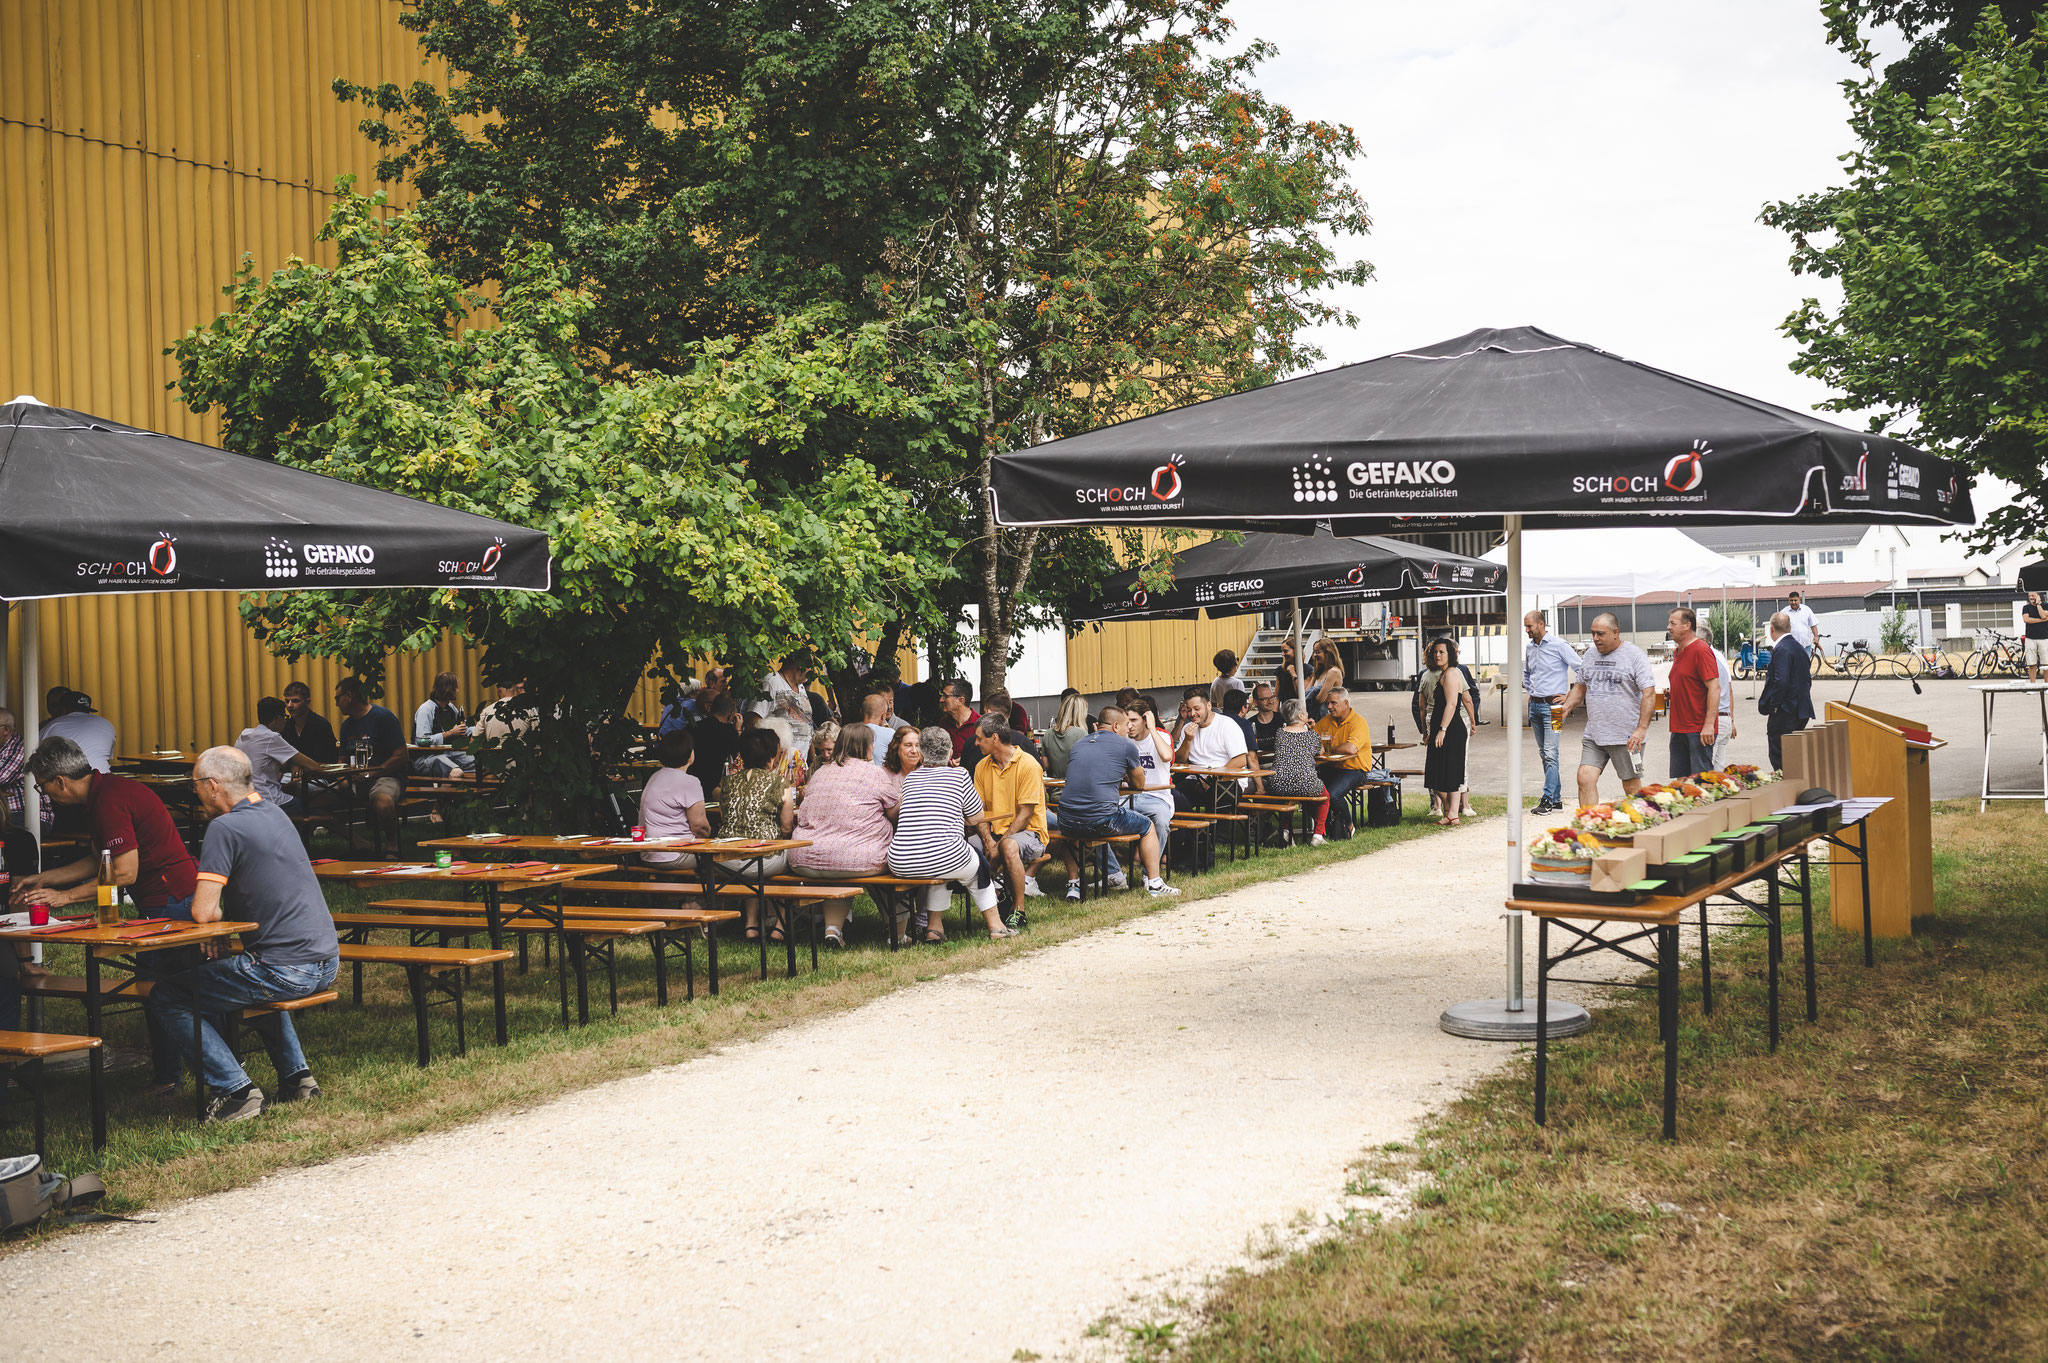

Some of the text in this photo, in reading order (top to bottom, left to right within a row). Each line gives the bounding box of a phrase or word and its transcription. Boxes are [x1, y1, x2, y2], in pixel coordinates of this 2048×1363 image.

[1346, 460, 1456, 486] GEFAKO
[1572, 476, 1659, 493] SCHOCH
[1075, 486, 1146, 503] SCHOCH
[1349, 487, 1458, 500] Die Getränkespezialisten
[303, 544, 375, 564] GEFAKO
[77, 561, 147, 576] SCHOCH
[305, 567, 376, 577] Die Getränkespezialisten
[438, 560, 480, 573] SCHOCH
[1218, 578, 1264, 593] GEFAKO
[1311, 578, 1347, 588] SCHOCH
[106, 837, 124, 848] OTTO
